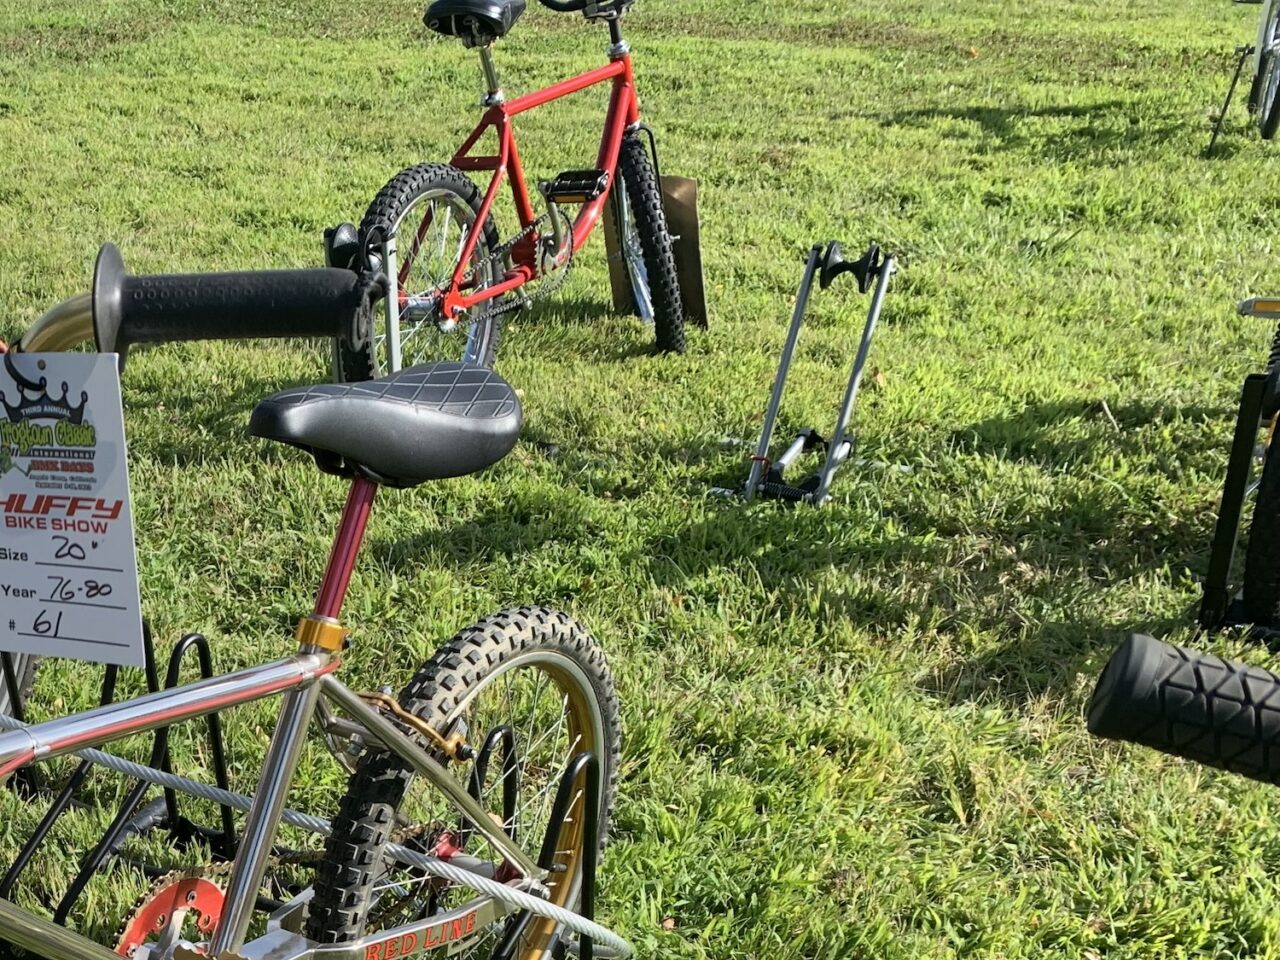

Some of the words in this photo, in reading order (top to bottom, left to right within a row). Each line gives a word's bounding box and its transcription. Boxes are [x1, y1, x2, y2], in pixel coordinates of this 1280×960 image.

[21, 405, 42, 416] THIRD
[43, 404, 71, 417] ANNUAL
[5, 515, 47, 530] BIKE
[51, 518, 108, 534] SHOW
[1, 583, 37, 599] Year
[8, 618, 16, 631] #
[32, 609, 63, 638] 61
[423, 910, 479, 949] LINE
